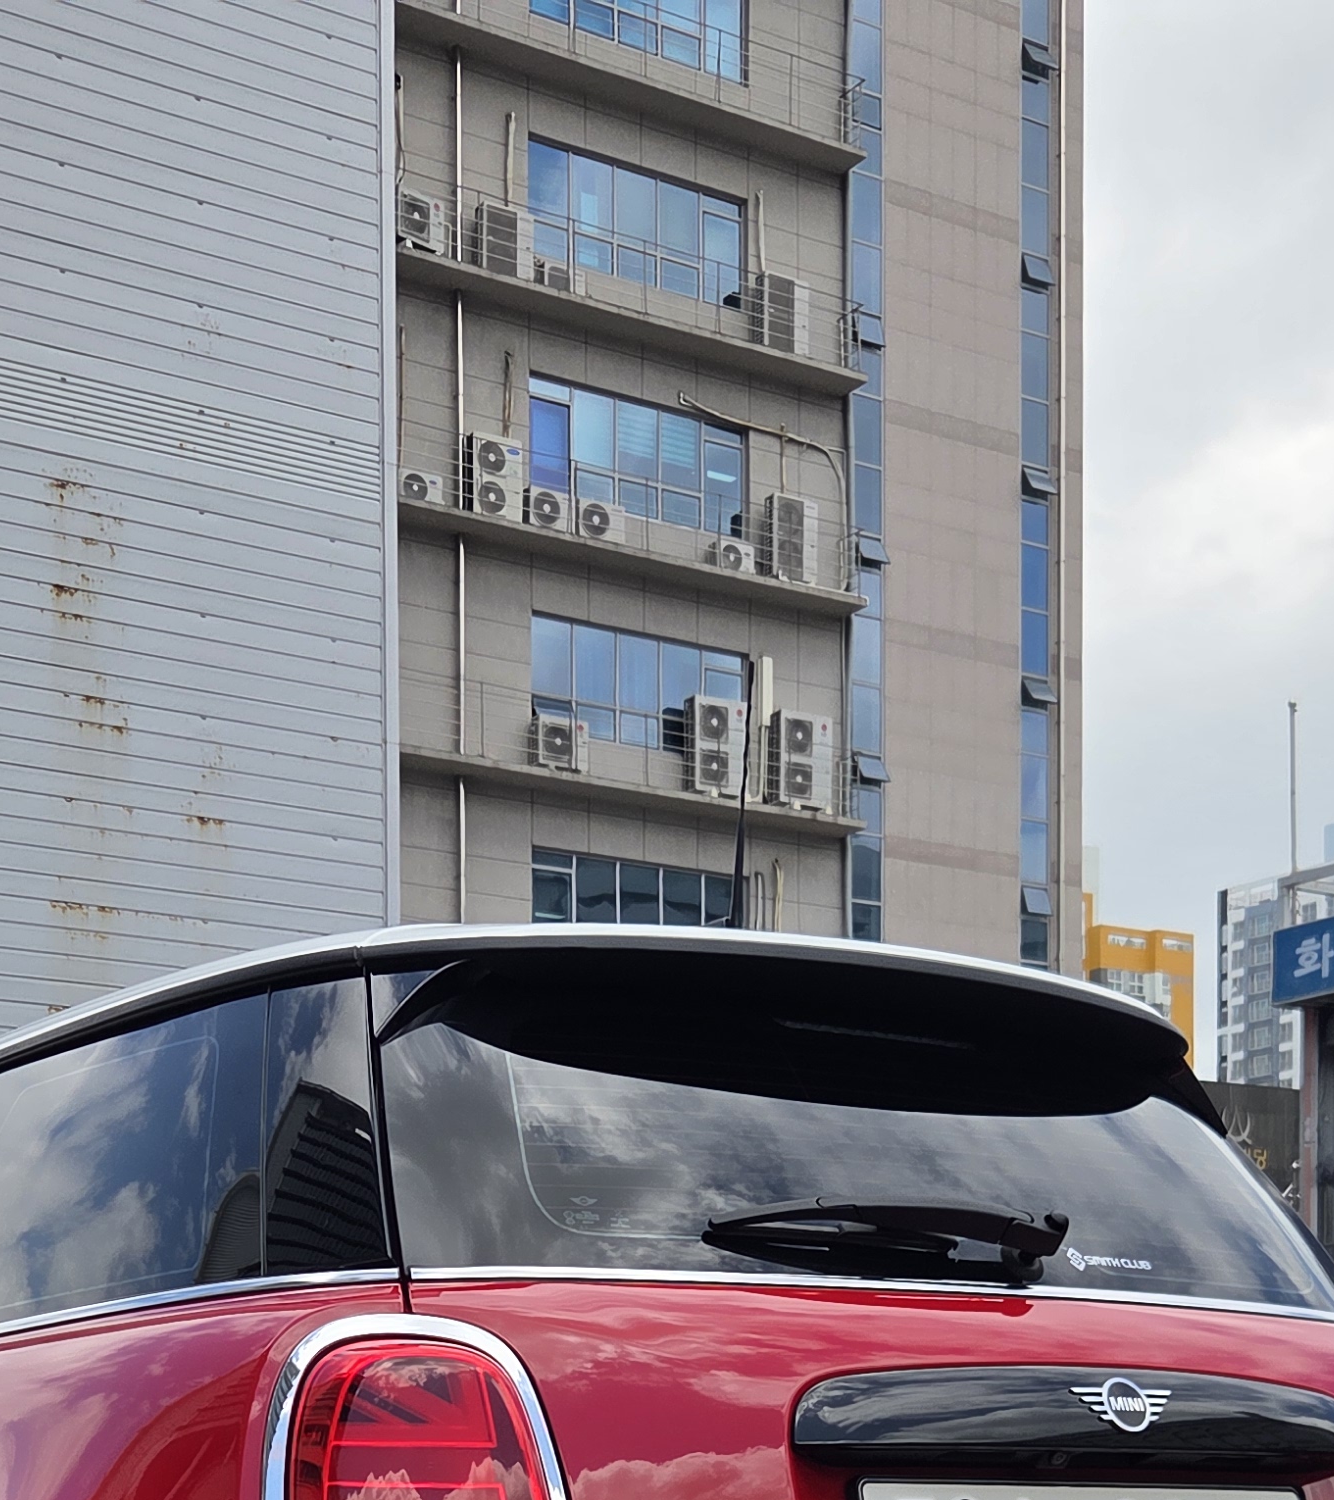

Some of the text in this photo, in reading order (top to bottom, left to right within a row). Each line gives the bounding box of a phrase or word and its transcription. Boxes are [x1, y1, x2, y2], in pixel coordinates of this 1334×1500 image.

[1083, 1255, 1152, 1270] SMITH CLUB
[1109, 1396, 1145, 1412] MINI
